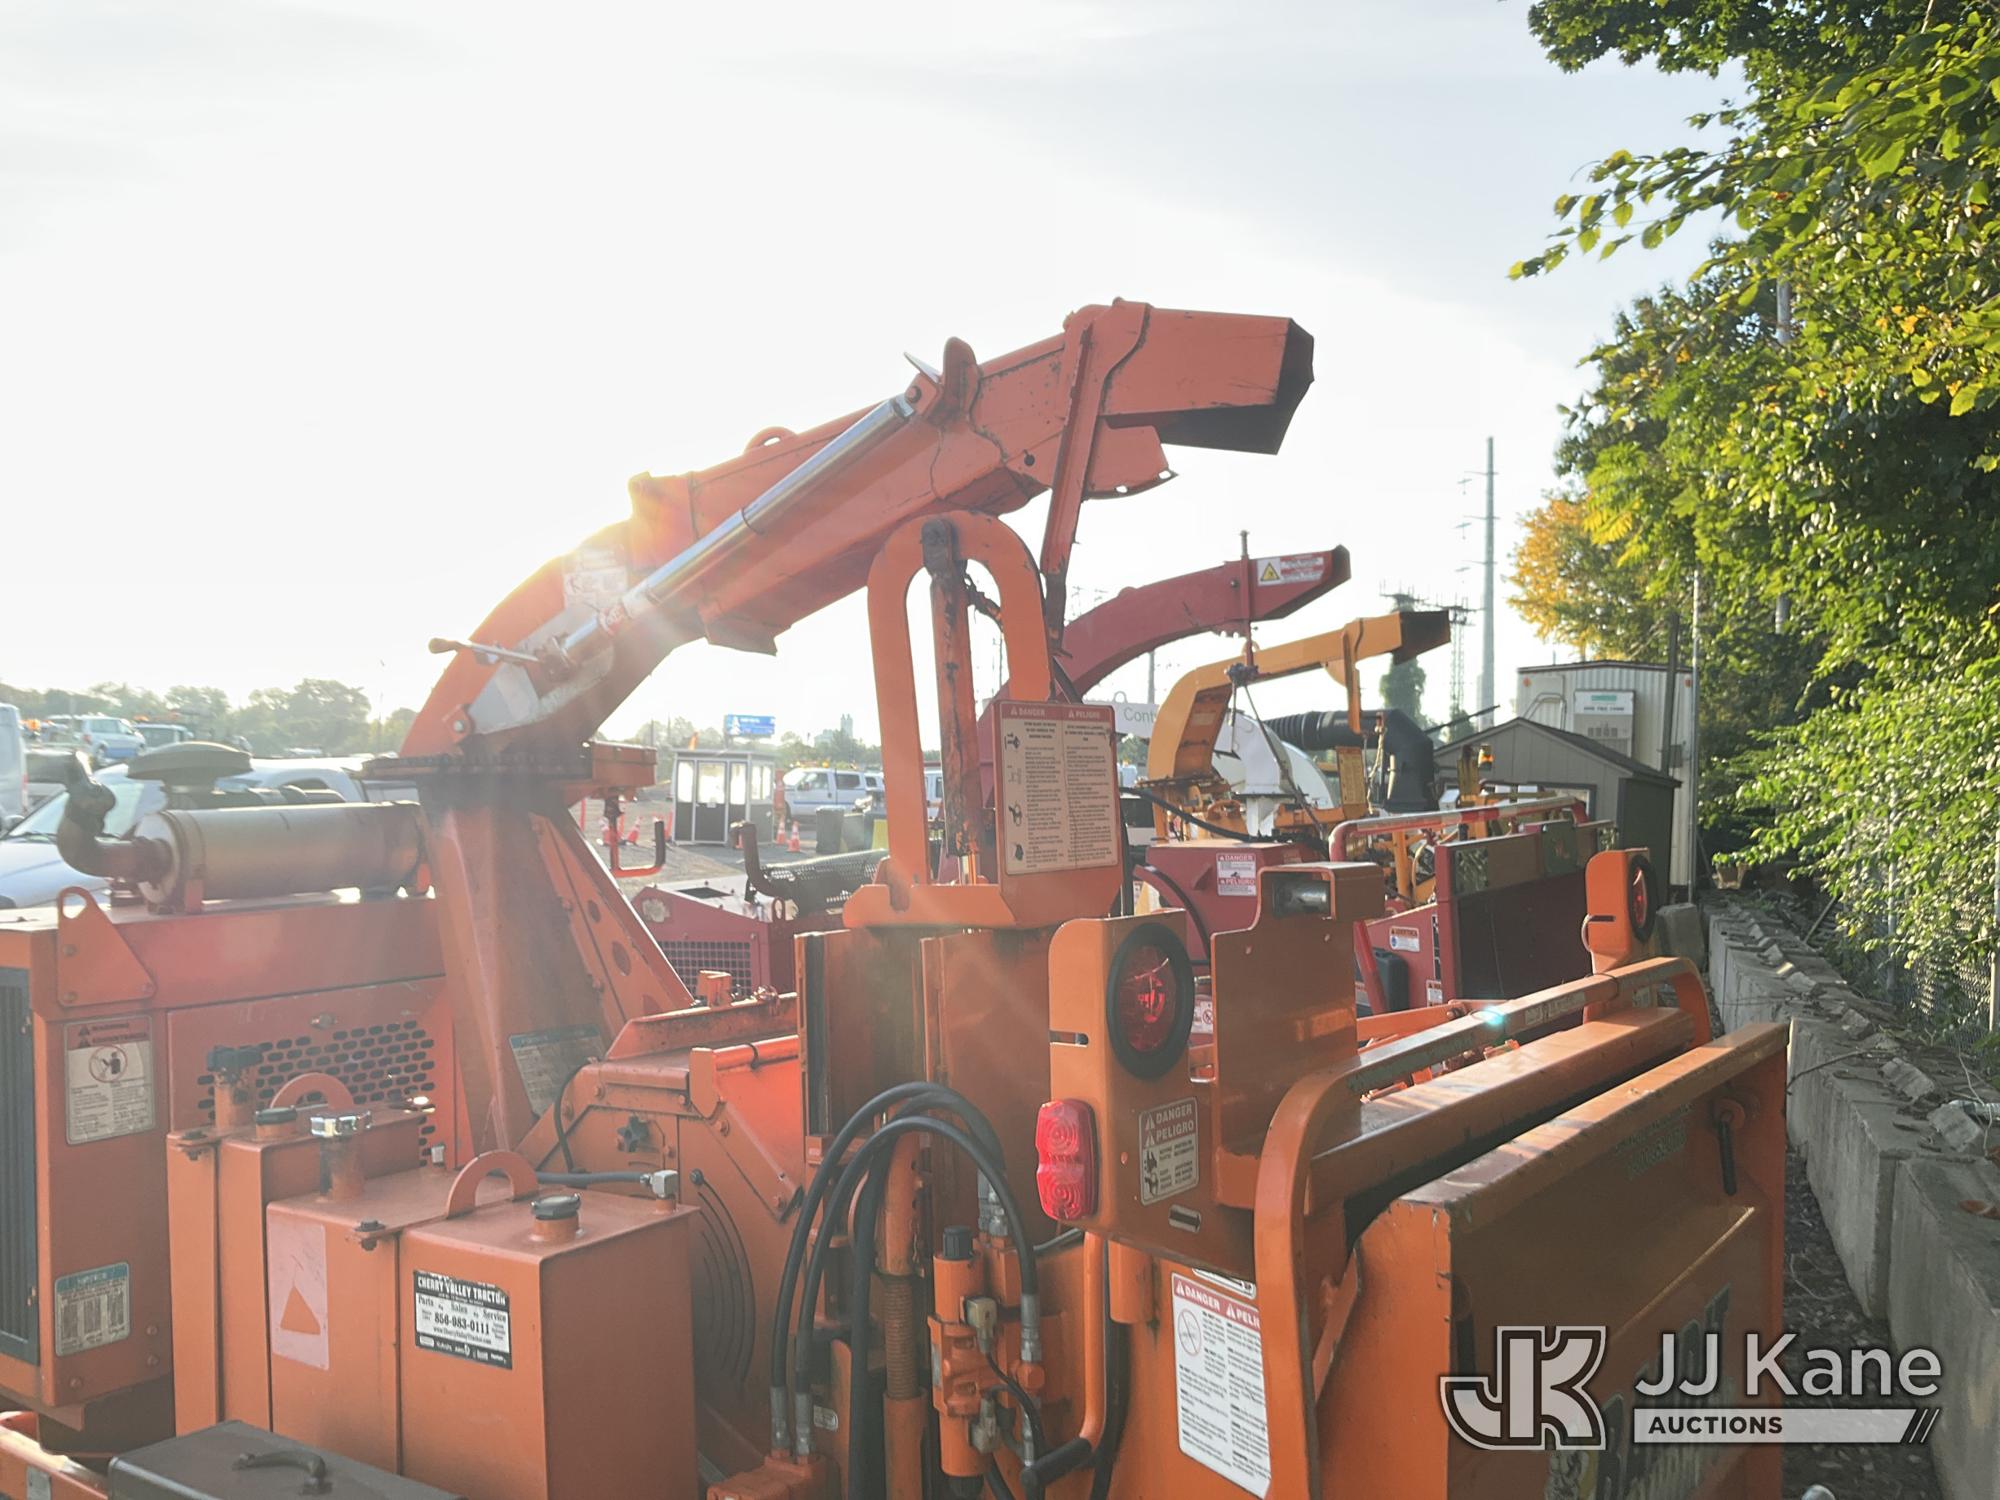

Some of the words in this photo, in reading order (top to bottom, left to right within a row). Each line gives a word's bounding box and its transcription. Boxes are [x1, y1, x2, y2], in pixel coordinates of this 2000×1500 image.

[1018, 707, 1046, 717] DANGER
[1226, 878, 1255, 886] PELIGRO
[1156, 1103, 1193, 1125] DANGER
[1156, 1119, 1195, 1142] PELIGRO
[417, 1276, 444, 1292] CHERRY
[445, 1281, 471, 1297] VALLEY
[418, 1294, 434, 1308] Parts
[1185, 1285, 1221, 1314] DANGER
[482, 1309, 507, 1323] Service
